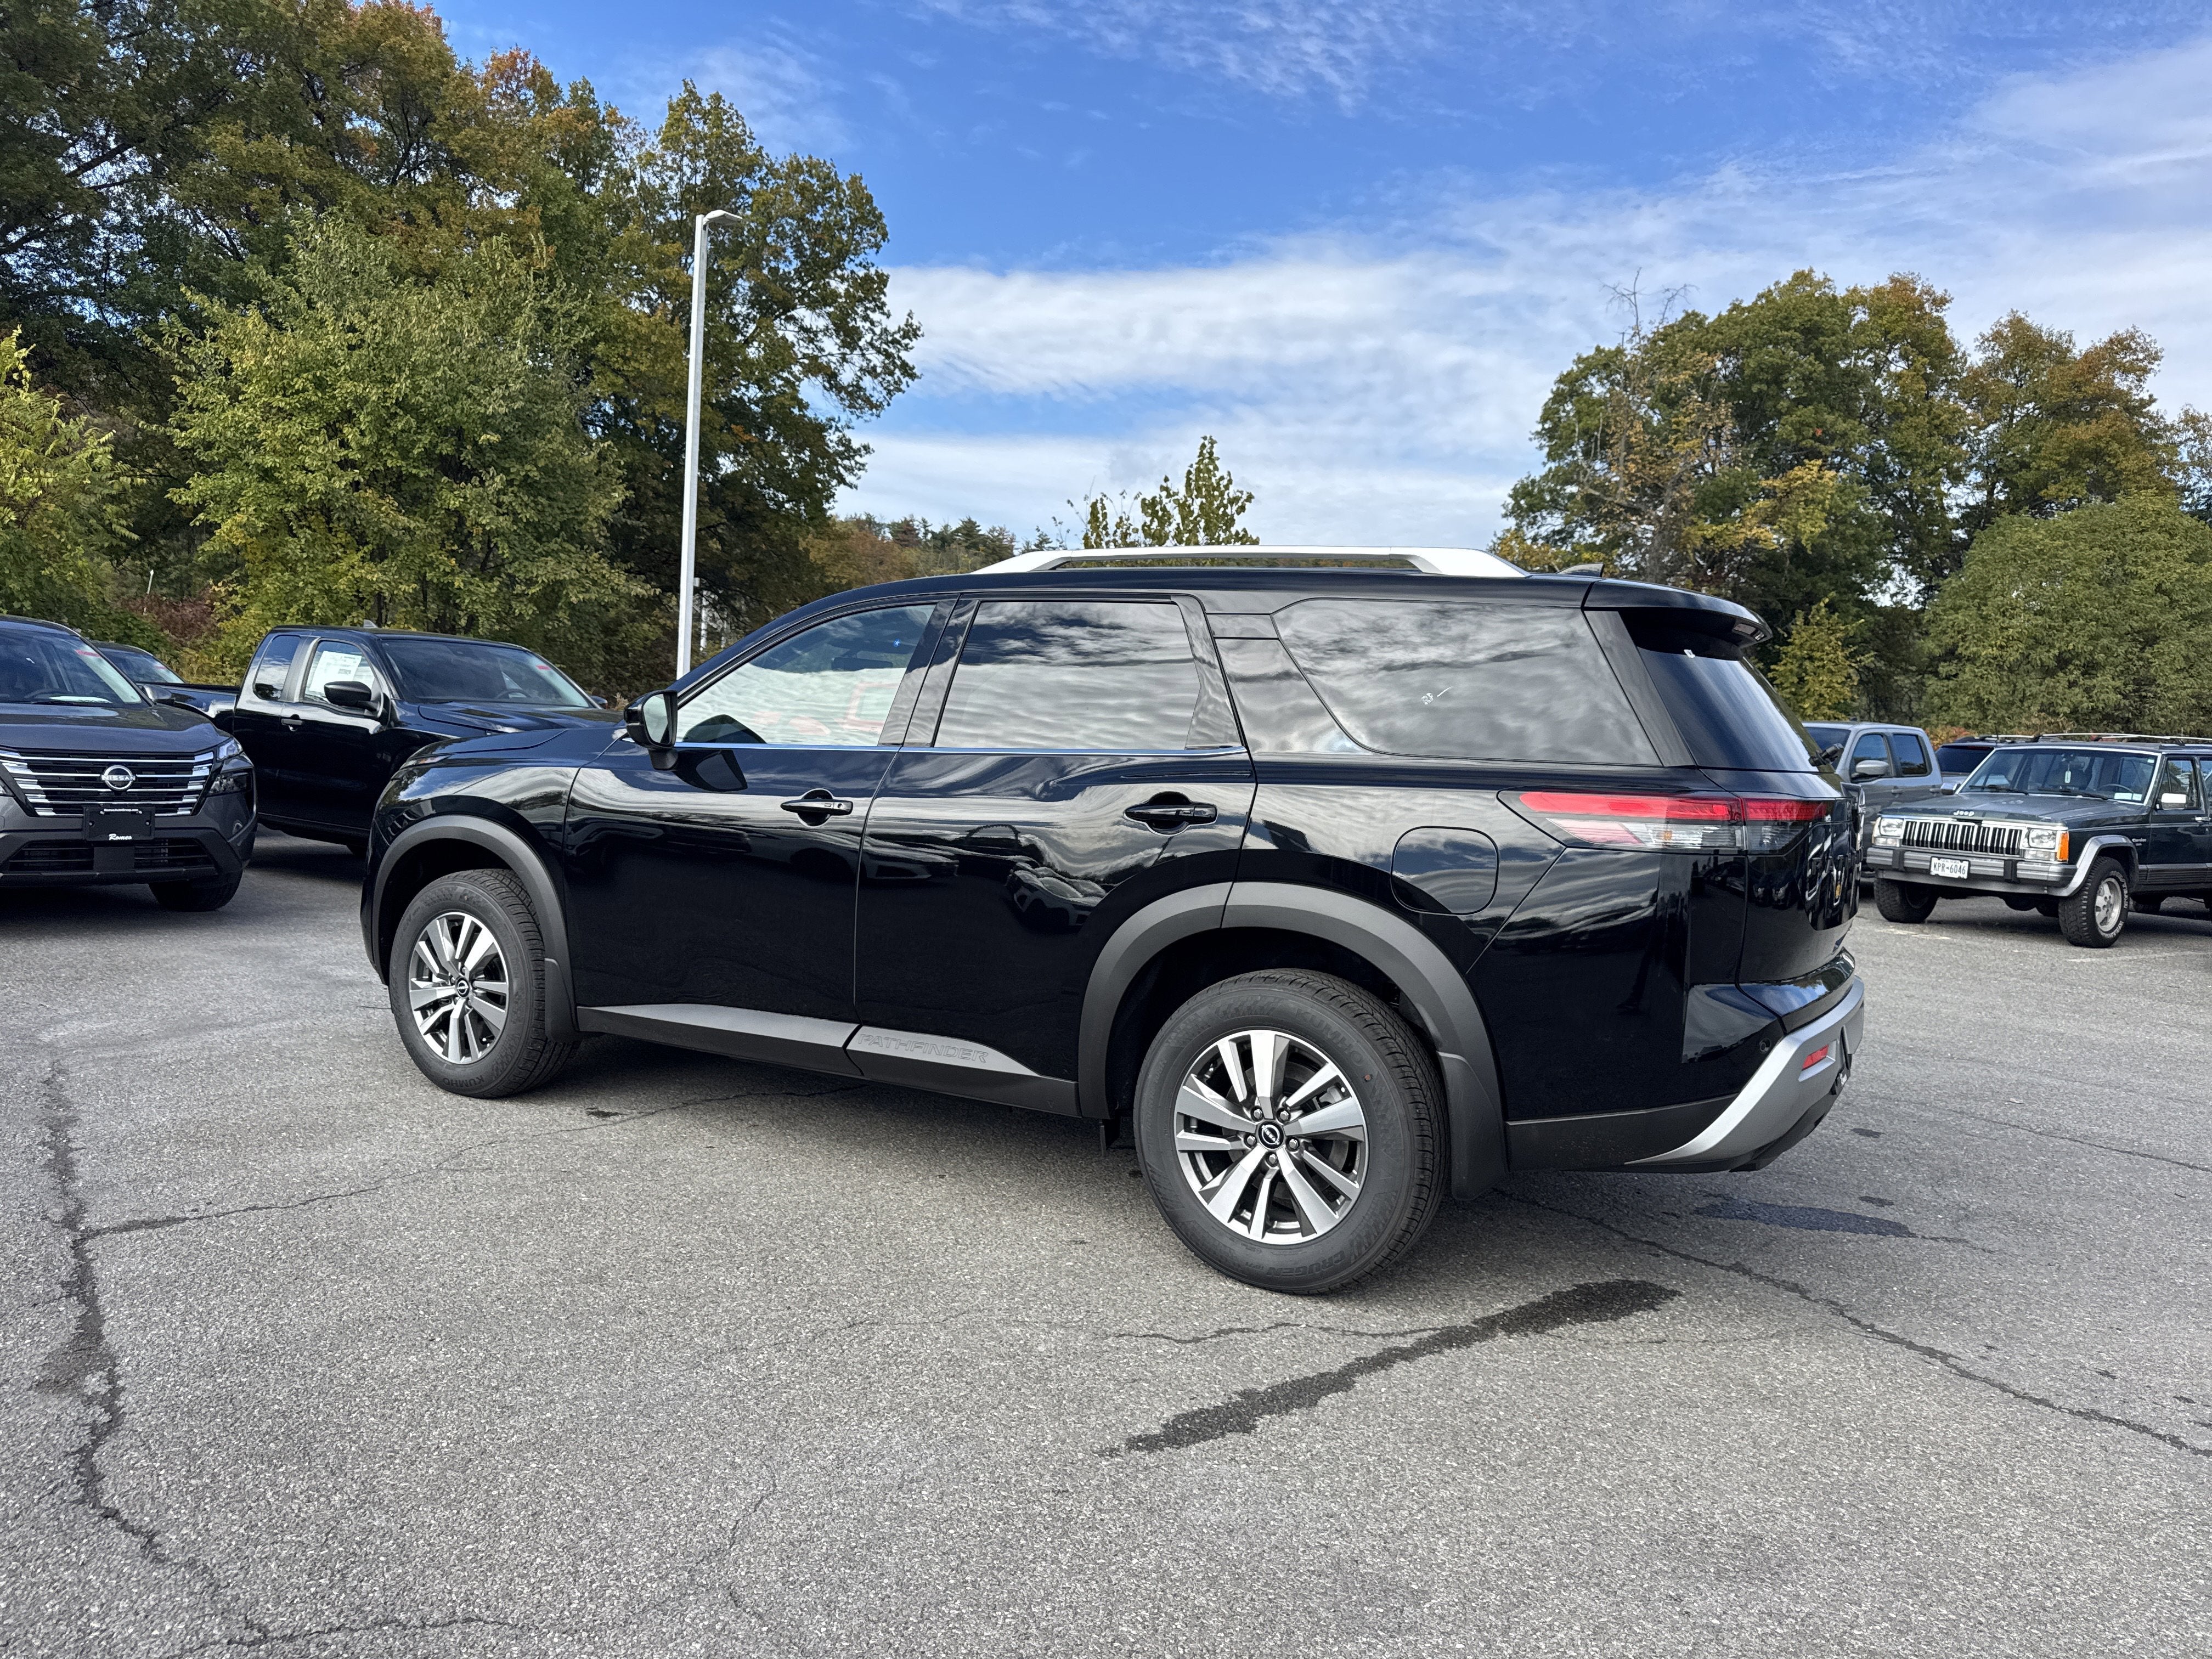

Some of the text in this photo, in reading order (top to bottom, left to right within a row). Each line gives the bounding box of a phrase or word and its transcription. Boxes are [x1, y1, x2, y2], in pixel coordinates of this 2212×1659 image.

[857, 1034, 989, 1063] PATHFINDER
[443, 1075, 484, 1087] KUMHO
[1267, 1250, 1345, 1277] CRUGEN
